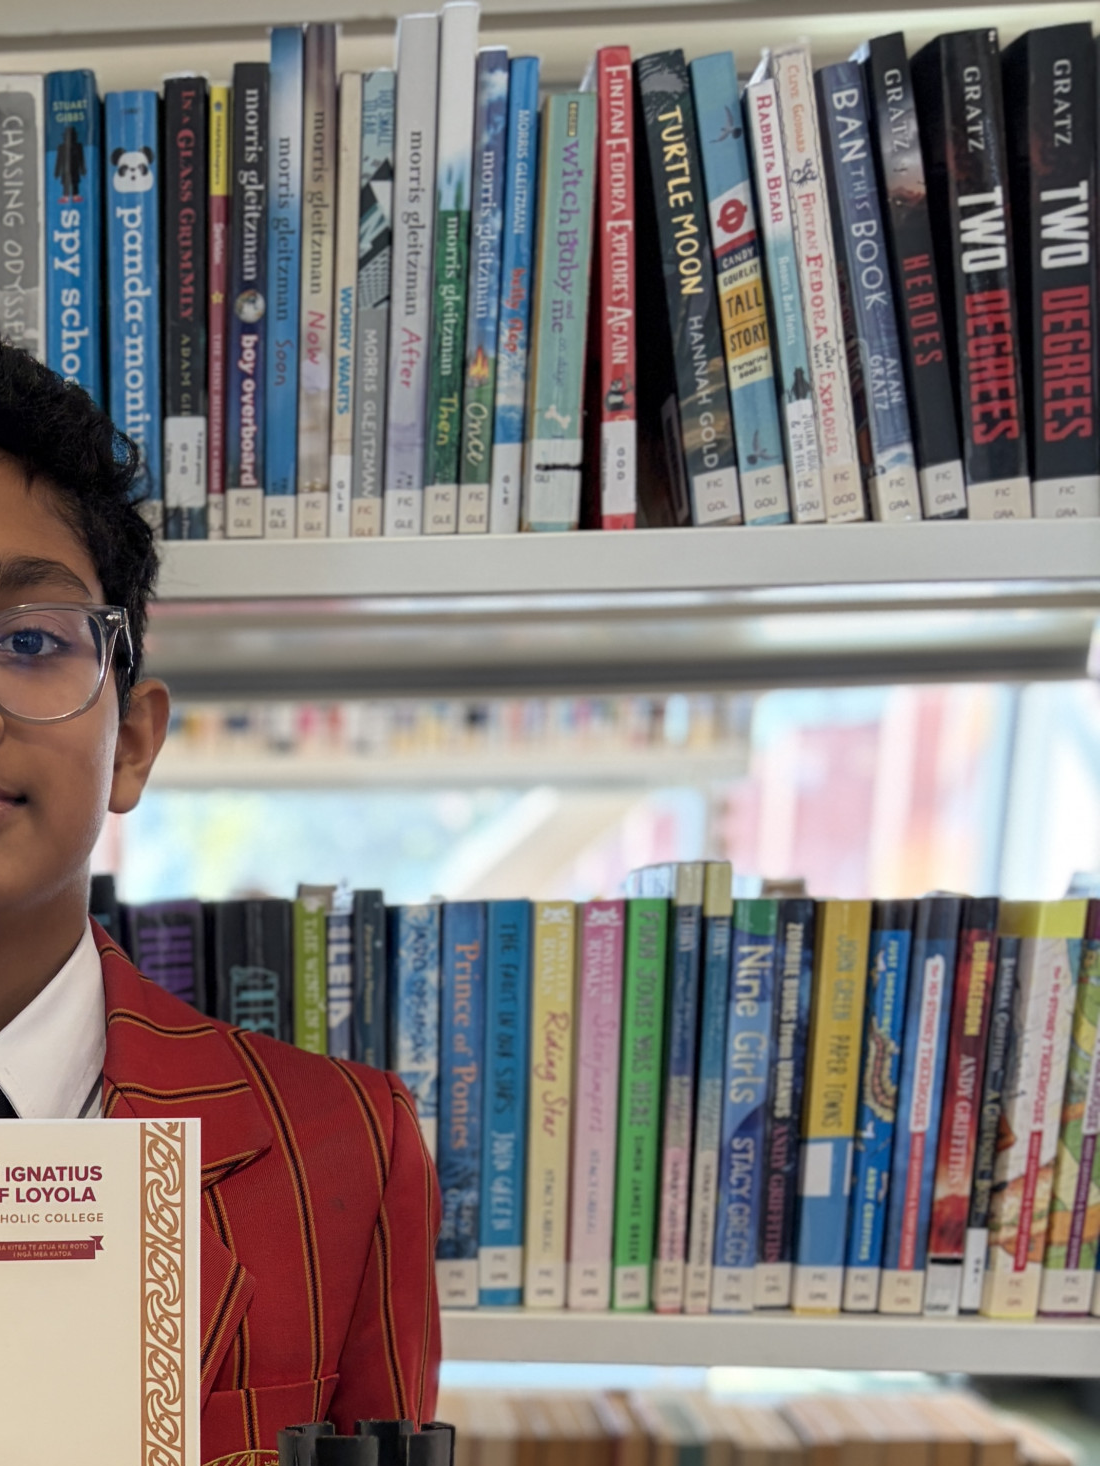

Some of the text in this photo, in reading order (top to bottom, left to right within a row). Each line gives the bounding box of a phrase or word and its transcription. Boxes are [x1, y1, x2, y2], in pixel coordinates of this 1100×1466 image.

[52, 99, 88, 111] STUART
[55, 112, 85, 123] GIBBS
[516, 109, 530, 160] MORRIS
[2, 115, 25, 228] CHASING
[176, 129, 195, 202] GLASS
[512, 162, 528, 235] GLEITZMAN
[657, 105, 704, 295] TURTLE MOON
[766, 175, 784, 224] BEAR
[832, 88, 889, 311] BAN THIS BOOK
[53, 209, 83, 277] spy
[306, 111, 330, 365] morris gleitzman Now
[605, 64, 632, 364] FINTAN FEDORA EXPLORES AGAIN
[798, 192, 819, 250] FINTAN
[884, 68, 944, 367] GRATZ HEROES
[176, 208, 197, 320] GRIMMLY
[272, 137, 294, 387] morris gleitzman Soon
[401, 131, 426, 389] morris gleitzman After
[722, 246, 755, 269] CANDY
[723, 263, 759, 287] GOURLAY
[957, 65, 1020, 445] GRATZ TWO DEGREES
[1040, 59, 1093, 443] GRATZ TWO DEGREES
[238, 88, 264, 488] morris gleitzman boy overboard
[465, 150, 497, 465] morris gleitzman Once
[551, 299, 567, 333] me
[726, 287, 762, 318] TALL
[805, 253, 828, 340] FEDORA
[181, 334, 192, 386] ADAM
[337, 286, 354, 415] WORRY WARTS
[437, 216, 462, 446] morris gleitzman Then
[729, 321, 766, 353] STORY
[360, 329, 378, 499] MORRIS GLEITZMAN
[688, 315, 719, 469] HANNAH GOLD
[819, 370, 839, 456] EXPLORER
[868, 354, 888, 411] GRATZ
[885, 357, 903, 403] ALAN
[706, 478, 723, 489] FIC
[707, 501, 729, 512] GOL
[754, 496, 777, 509] GOU
[755, 475, 772, 486] FIC
[833, 471, 850, 483] FIC
[833, 492, 857, 505] GOD
[452, 940, 482, 1150] Prince of Ponies
[725, 944, 773, 1265] Nine Girls STACY GREGG
[5, 1165, 103, 1183] IGNATIUS
[15, 1187, 96, 1203] LOYOLA
[44, 1212, 104, 1223] COLLEGE
